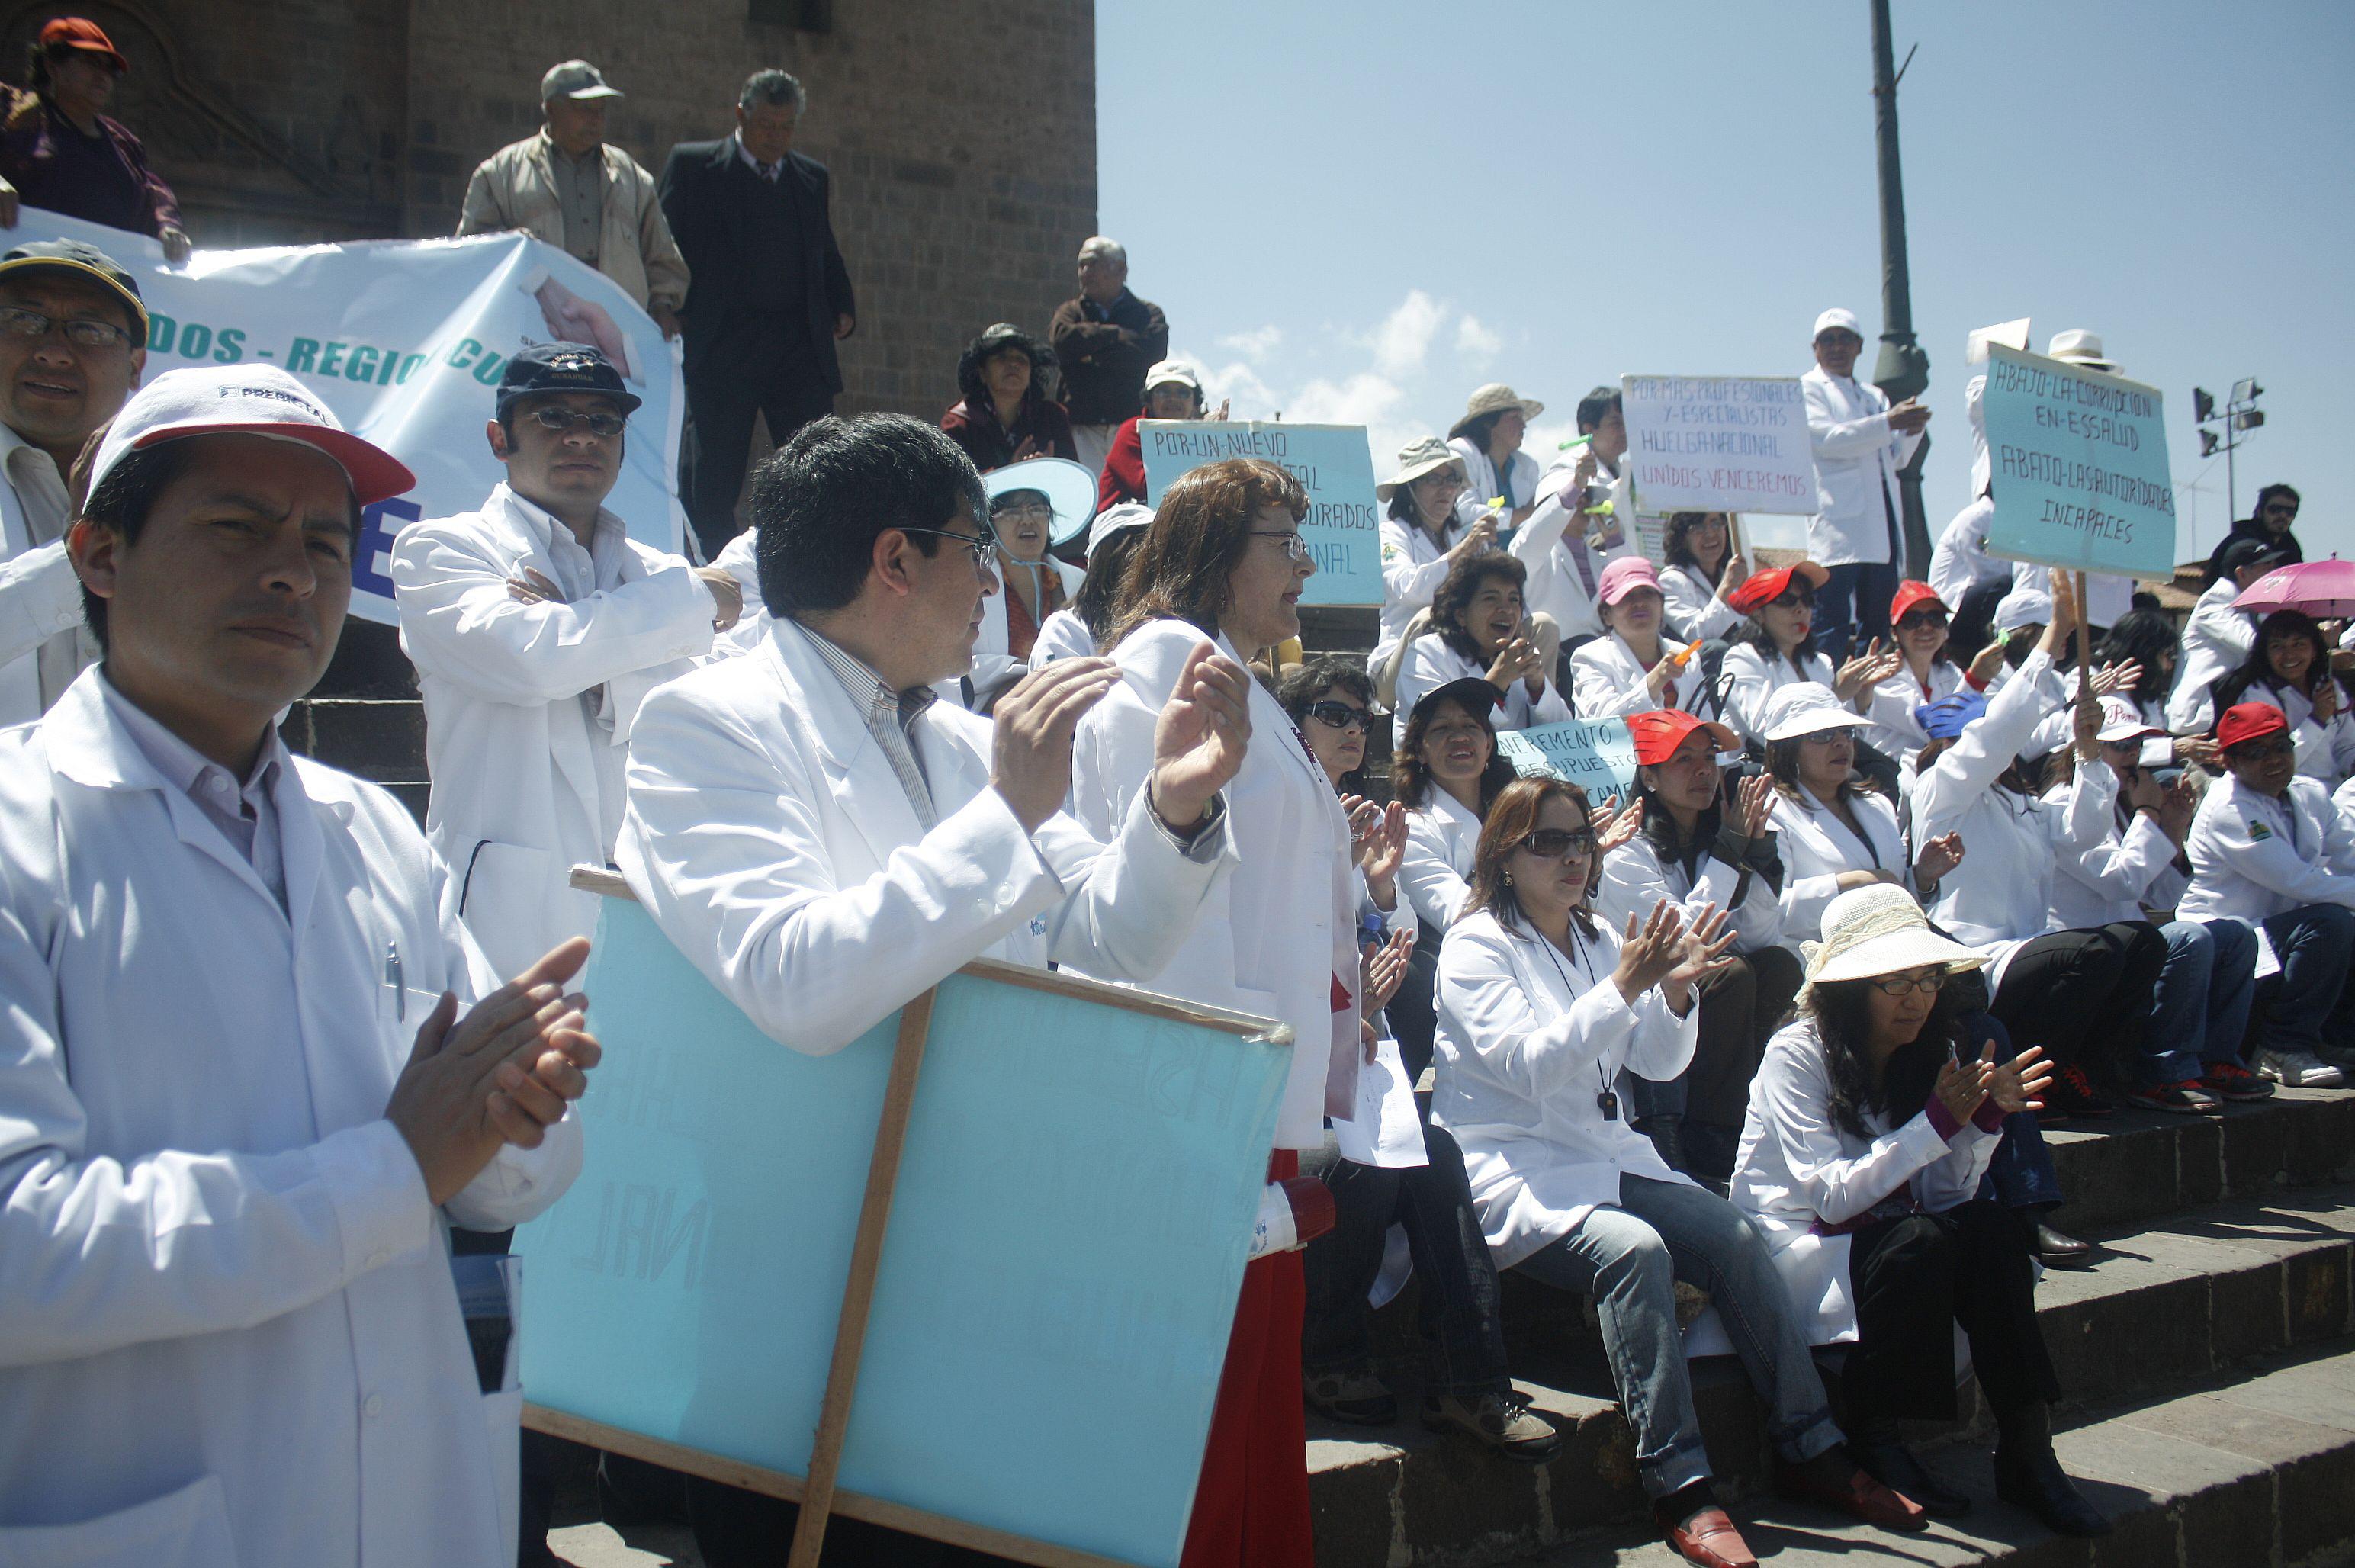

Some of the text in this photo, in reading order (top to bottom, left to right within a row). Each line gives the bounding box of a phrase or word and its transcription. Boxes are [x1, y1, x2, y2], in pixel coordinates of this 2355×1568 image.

[285, 336, 442, 386] REGIO
[2039, 499, 2134, 544] INCAPACES
[1497, 725, 1612, 755] NCREMENTO
